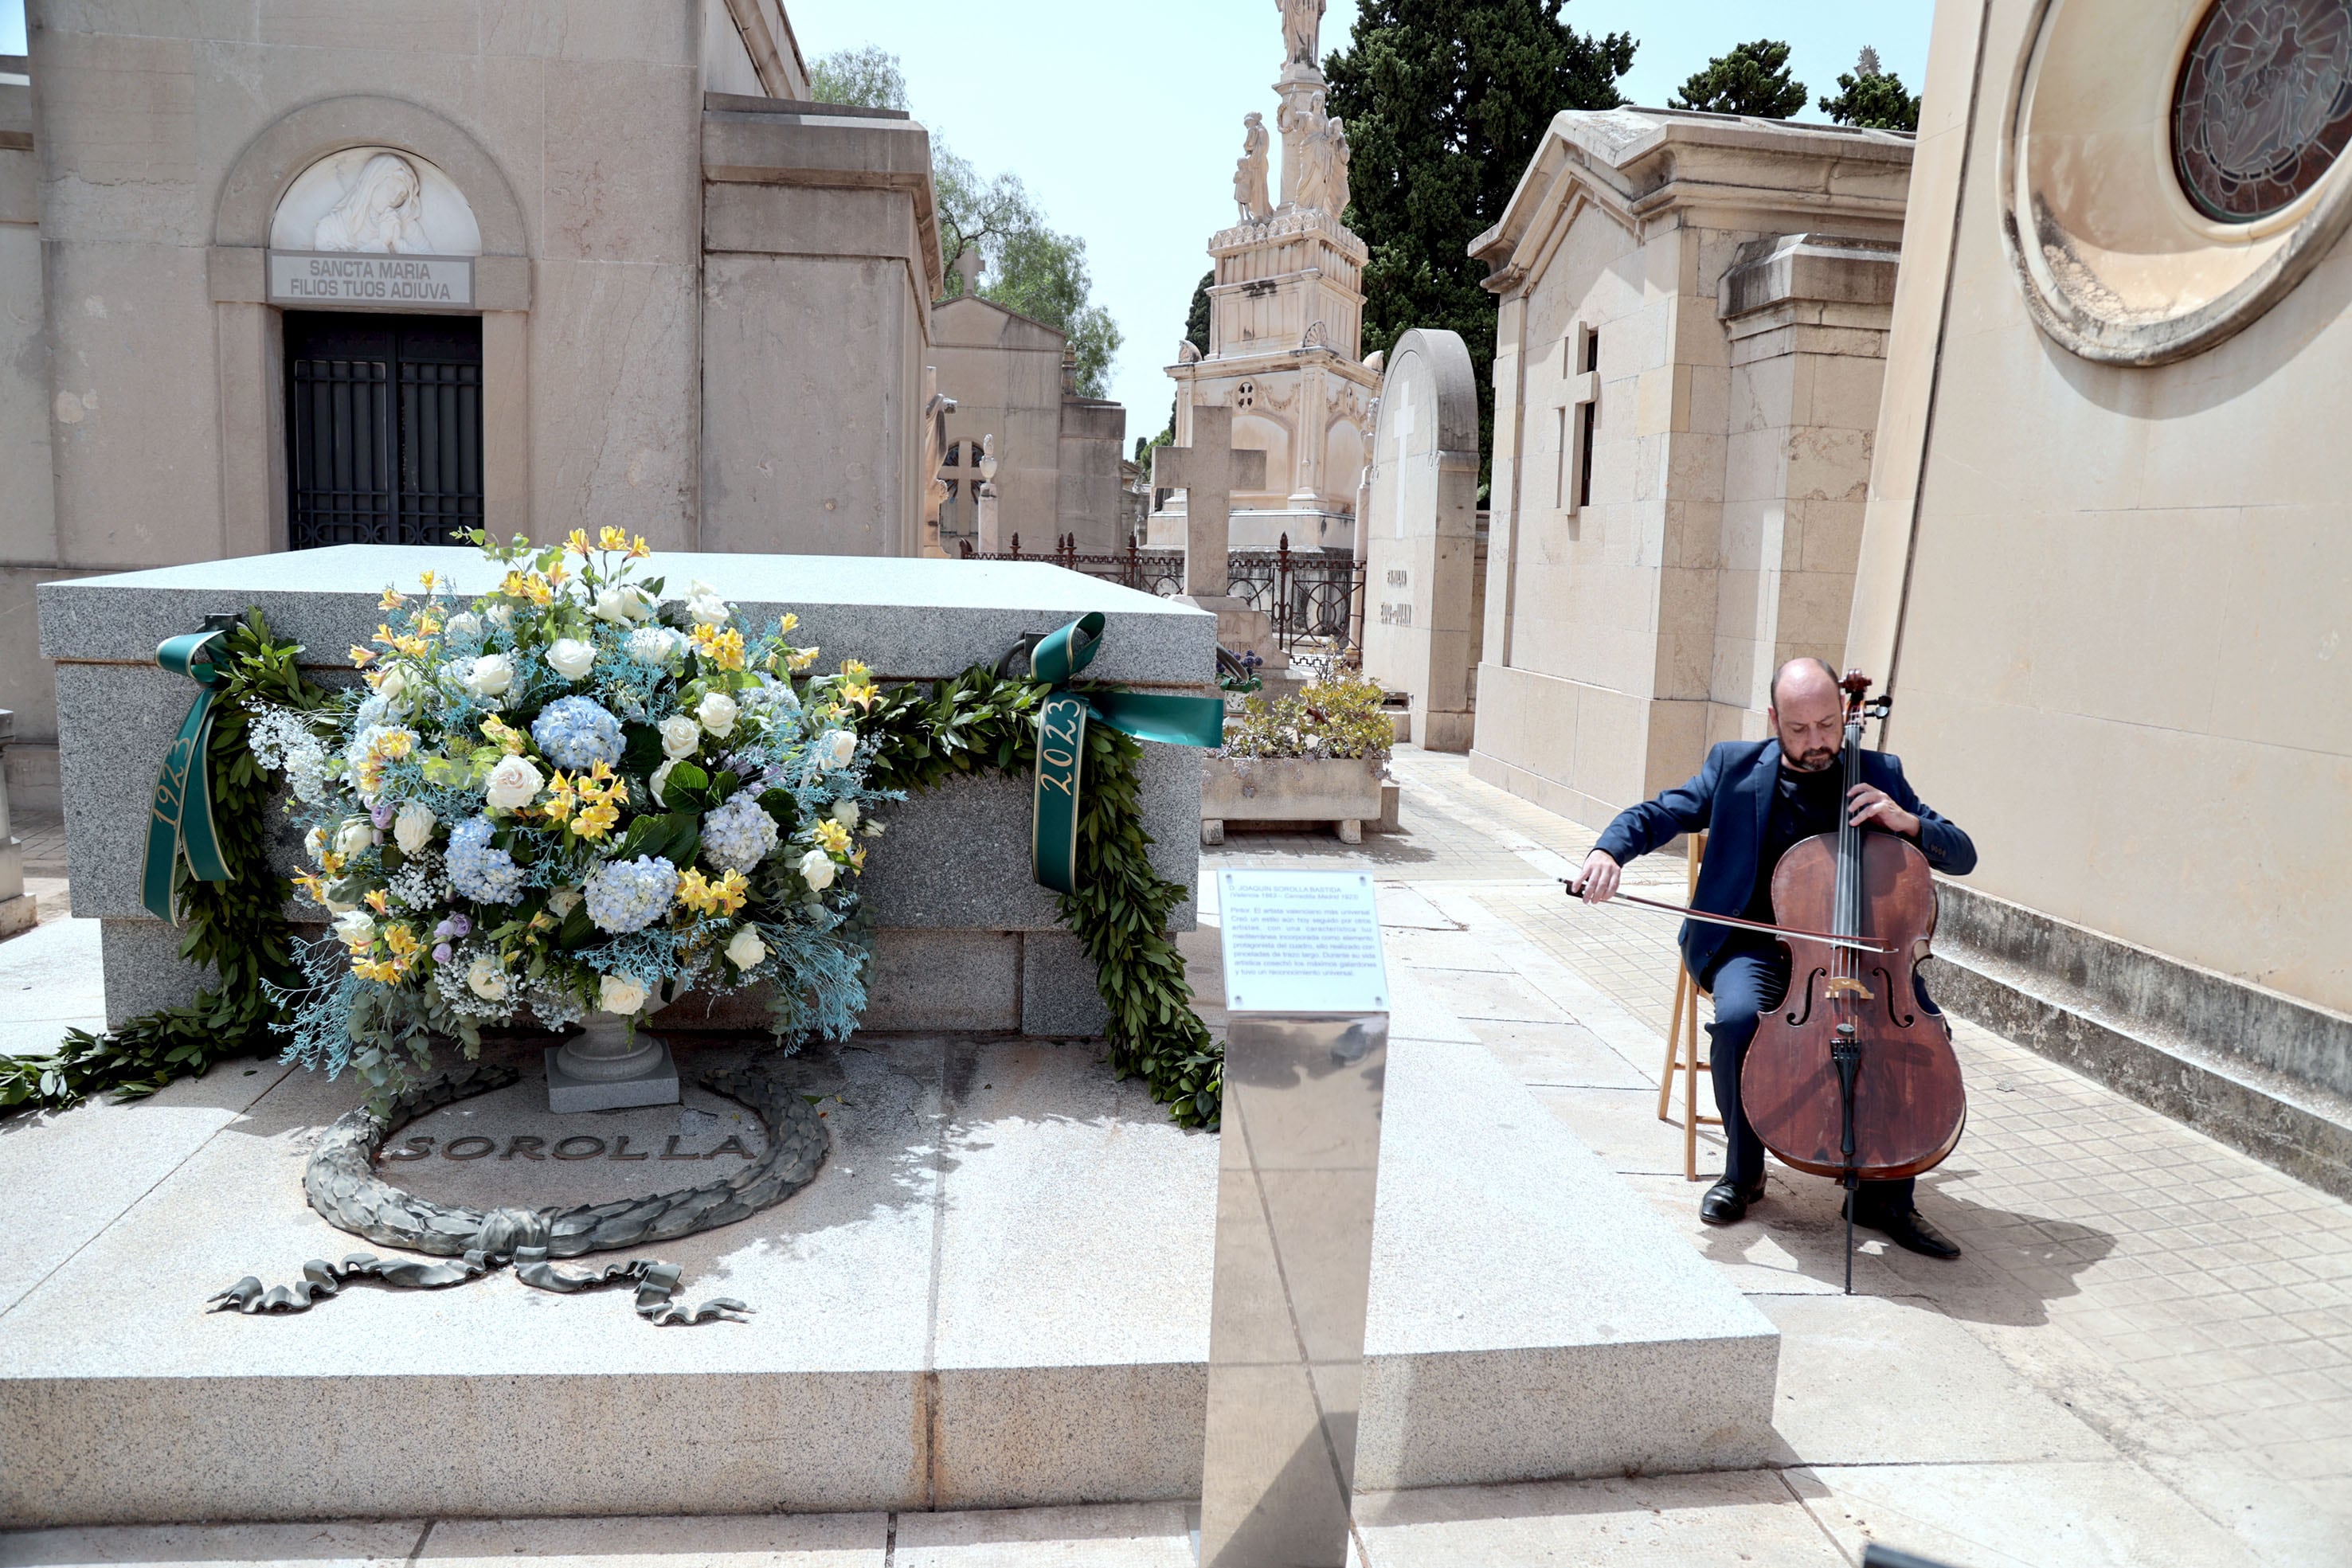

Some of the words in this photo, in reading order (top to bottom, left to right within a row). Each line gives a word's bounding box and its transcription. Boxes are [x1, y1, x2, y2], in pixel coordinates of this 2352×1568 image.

[310, 260, 374, 279] SANCTA
[379, 261, 432, 280] MARIA
[290, 279, 339, 296] FILIOS
[342, 280, 386, 298] TUOS
[390, 283, 451, 300] ADIUVA
[1040, 698, 1081, 796] 2023
[152, 737, 191, 831] 1923
[389, 1134, 757, 1161] SOROLLA
